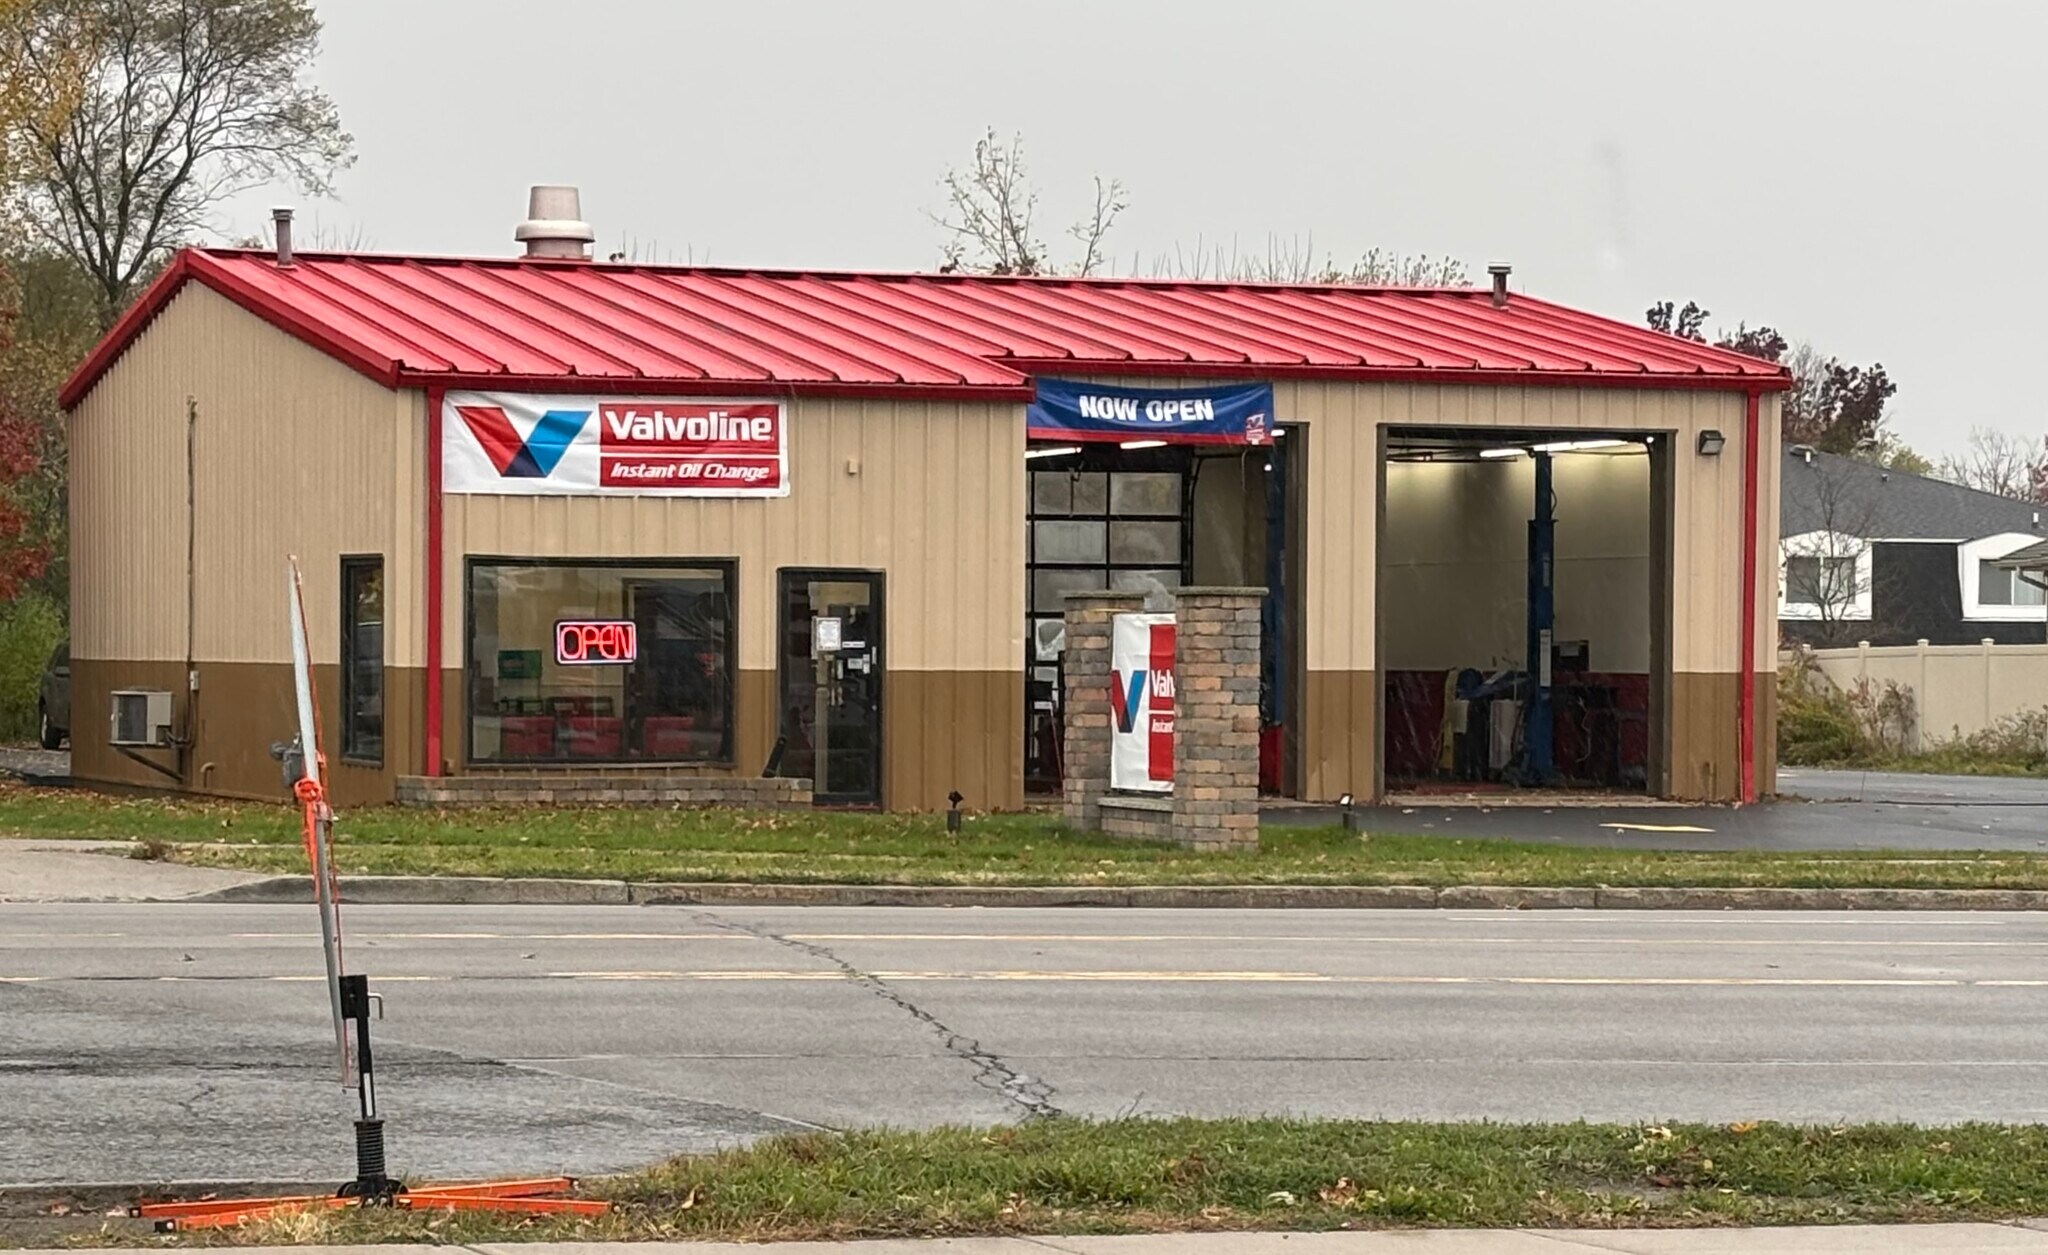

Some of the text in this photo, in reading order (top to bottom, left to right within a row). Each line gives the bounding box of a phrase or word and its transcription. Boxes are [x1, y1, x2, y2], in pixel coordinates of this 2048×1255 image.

[1079, 395, 1214, 423] NOW OPEN
[605, 410, 772, 442] Valvoline
[611, 461, 770, 481] Instant Oil Change
[560, 625, 634, 660] OPEN
